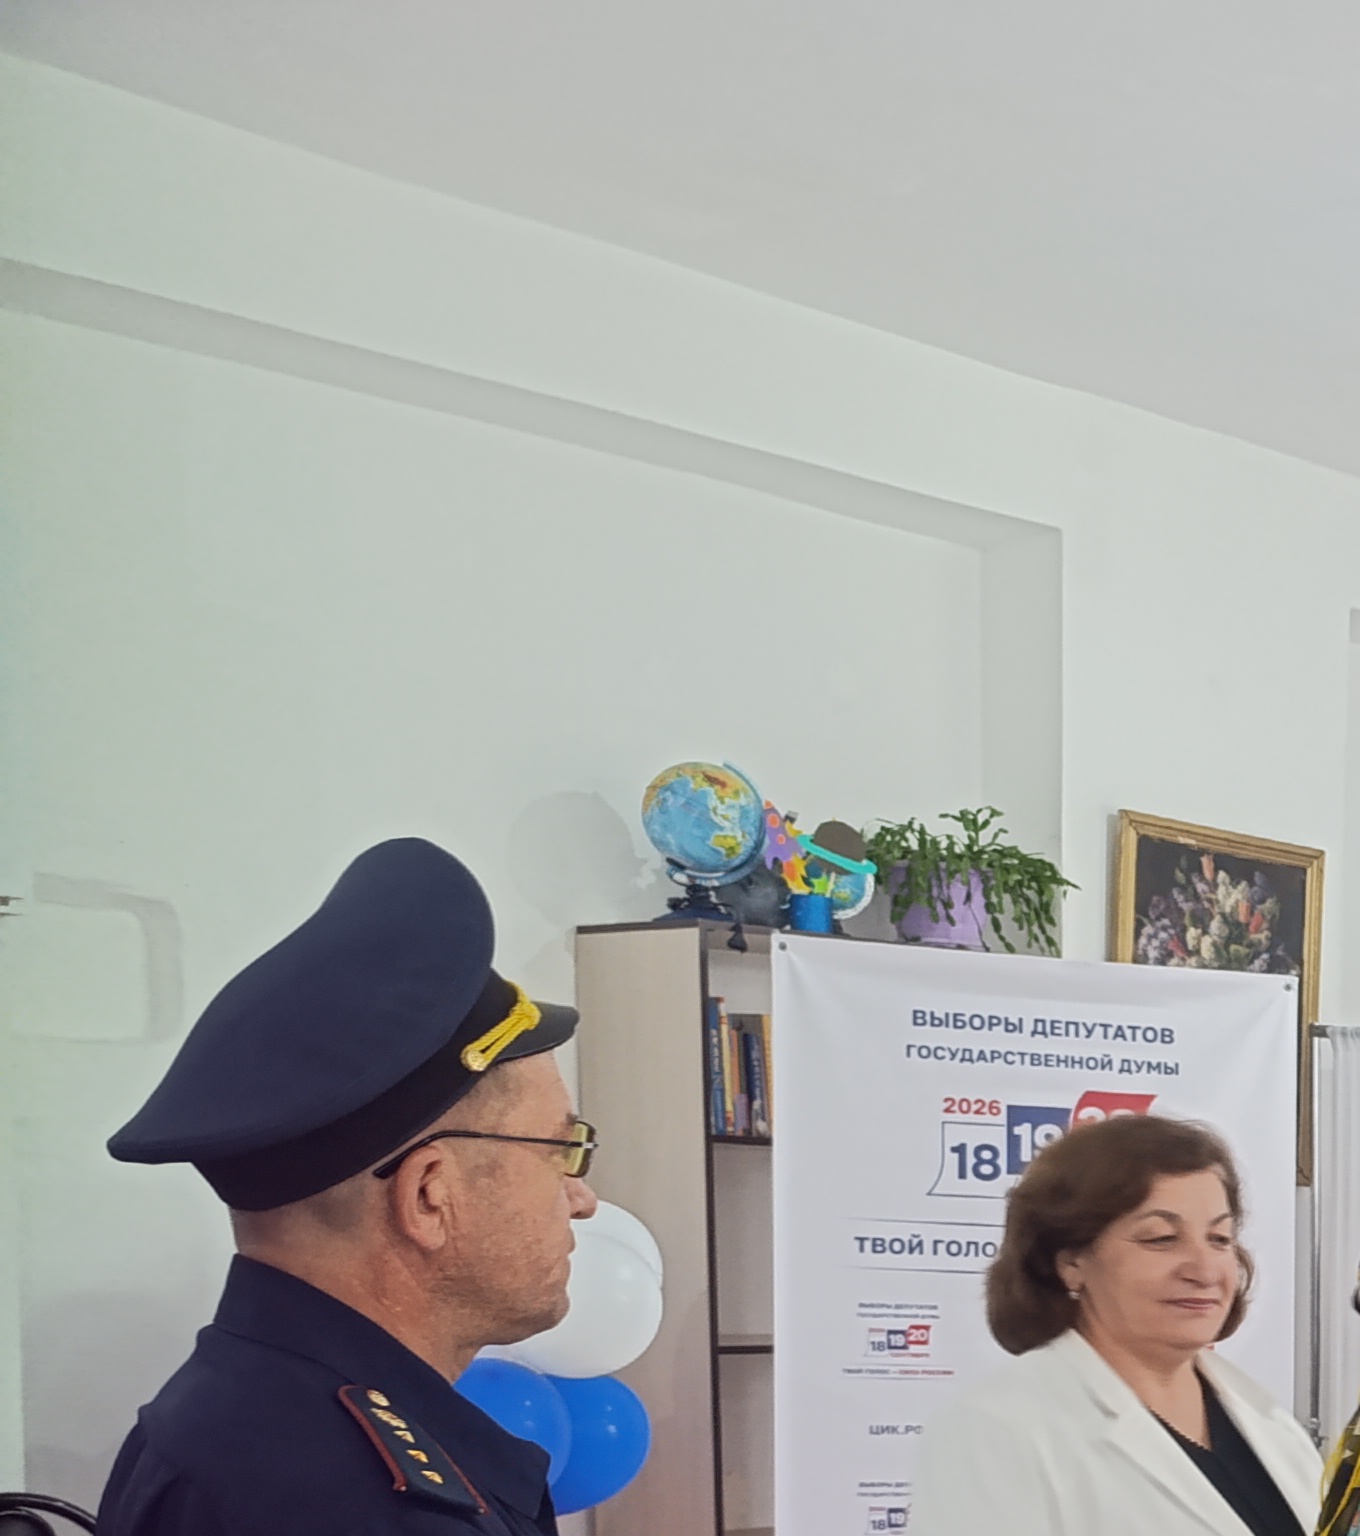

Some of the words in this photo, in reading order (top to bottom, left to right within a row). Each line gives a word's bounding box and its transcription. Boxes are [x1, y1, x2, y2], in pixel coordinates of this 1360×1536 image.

[911, 1008, 1024, 1035] ВЫБОРЫ
[1030, 1018, 1176, 1045] ДЕПУТАТОВ
[905, 1044, 1114, 1072] ГОСУДАРСТВЕННОЙ
[1118, 1058, 1180, 1076] ДУМЫ
[942, 1097, 1001, 1117] 2026
[950, 1142, 1001, 1181] 18
[854, 1233, 924, 1255] ТВОЙ
[932, 1239, 999, 1258] ГОЛО
[888, 1333, 906, 1347] 19
[907, 1328, 928, 1342] 20
[870, 1341, 886, 1352] 18
[870, 1519, 887, 1531] 18
